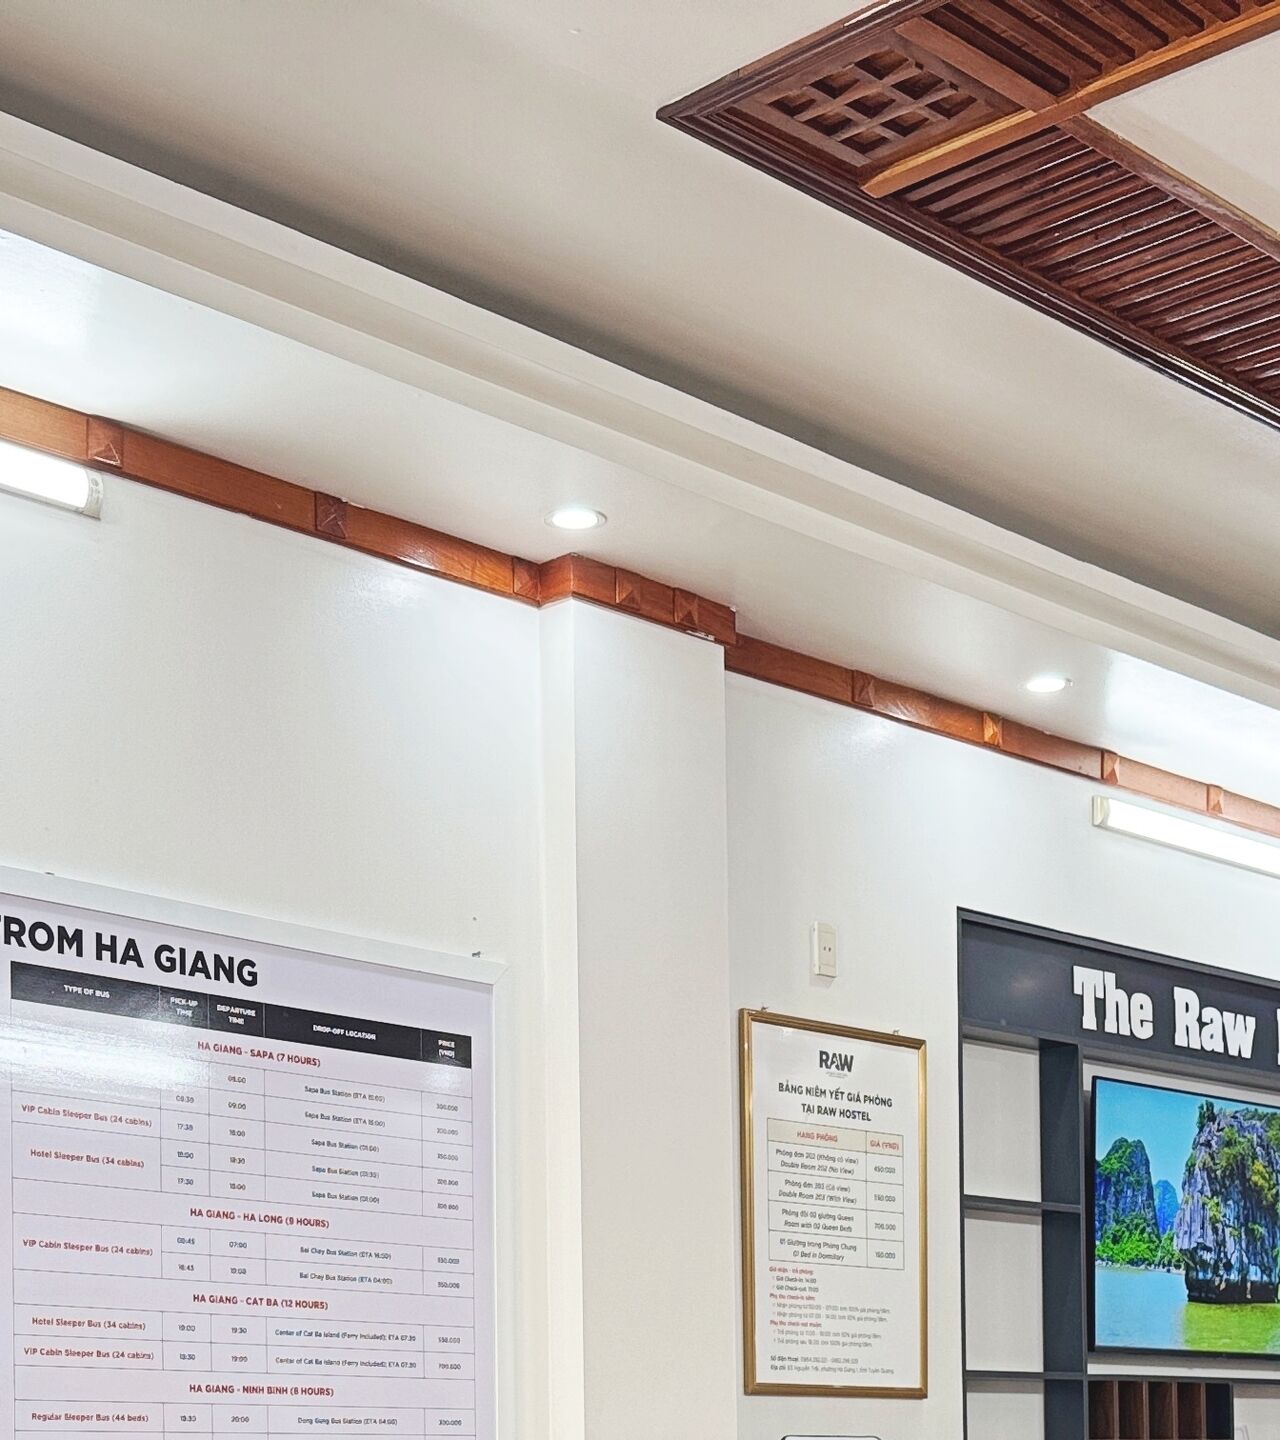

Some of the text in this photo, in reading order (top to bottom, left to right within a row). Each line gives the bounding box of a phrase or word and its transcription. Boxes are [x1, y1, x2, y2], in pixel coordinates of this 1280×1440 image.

[95, 931, 145, 969] HA
[153, 943, 258, 988] GIANG
[1073, 965, 1153, 1040] The
[1173, 986, 1256, 1059] Raw
[197, 1040, 211, 1051] HA
[212, 1042, 243, 1056] GIANG
[249, 1048, 275, 1061] SAPA
[276, 1052, 286, 1063] (7
[286, 1053, 321, 1068] HOURS)
[819, 1050, 854, 1072] RAW
[817, 1105, 837, 1117] RAW
[839, 1109, 872, 1121] HOSTEL
[189, 1207, 204, 1218] HA
[205, 1208, 236, 1221] GIANG
[242, 1212, 257, 1223] HA
[258, 1213, 284, 1225] LONG
[295, 1217, 330, 1229] HOURS)
[192, 1293, 207, 1303] HA
[208, 1294, 238, 1305] GIANG
[245, 1296, 265, 1306] CAT
[265, 1297, 279, 1307] BA
[280, 1298, 293, 1308] (12
[294, 1299, 329, 1311] HOURS)
[188, 1383, 204, 1393] HA
[204, 1383, 235, 1394] GIANG
[242, 1385, 265, 1395] NINH
[266, 1385, 288, 1395] BINH
[300, 1386, 334, 1398] HOURS)
